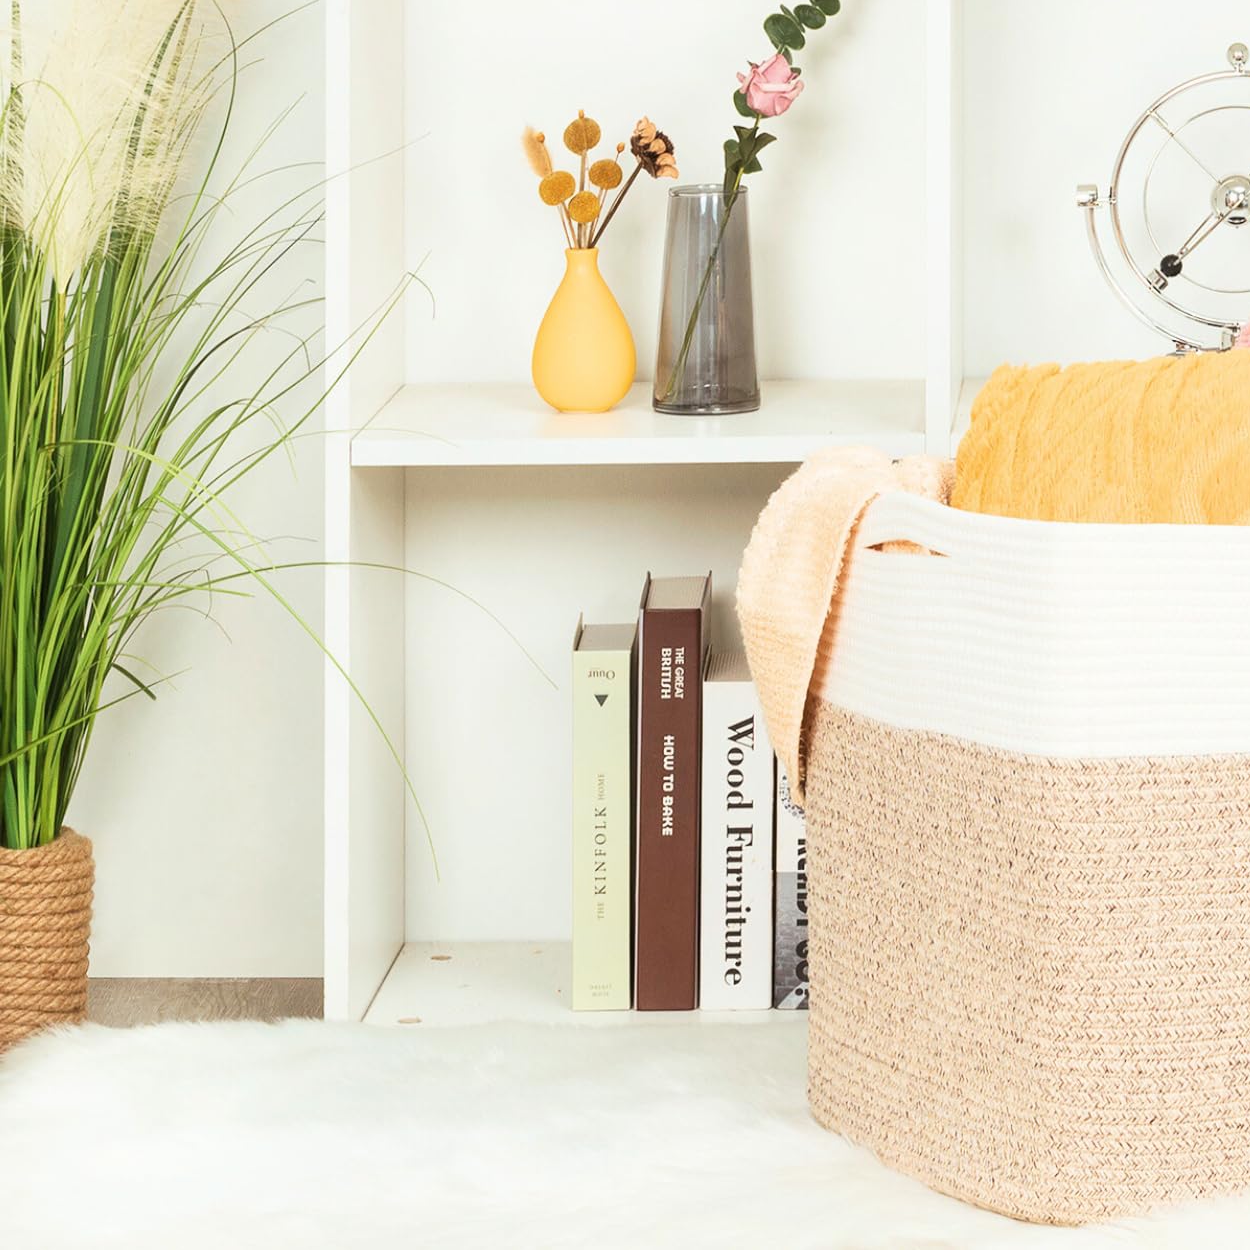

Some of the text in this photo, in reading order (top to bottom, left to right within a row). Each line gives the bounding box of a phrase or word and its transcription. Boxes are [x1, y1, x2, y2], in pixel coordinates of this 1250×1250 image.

[587, 669, 616, 680] Ouur
[660, 647, 672, 699] BRITISH
[674, 647, 684, 699] THE GREAT
[662, 734, 675, 836] HOW TO BAKE
[594, 773, 607, 920] THE KINFOLK HOME
[723, 714, 755, 987] Wood Furniture
